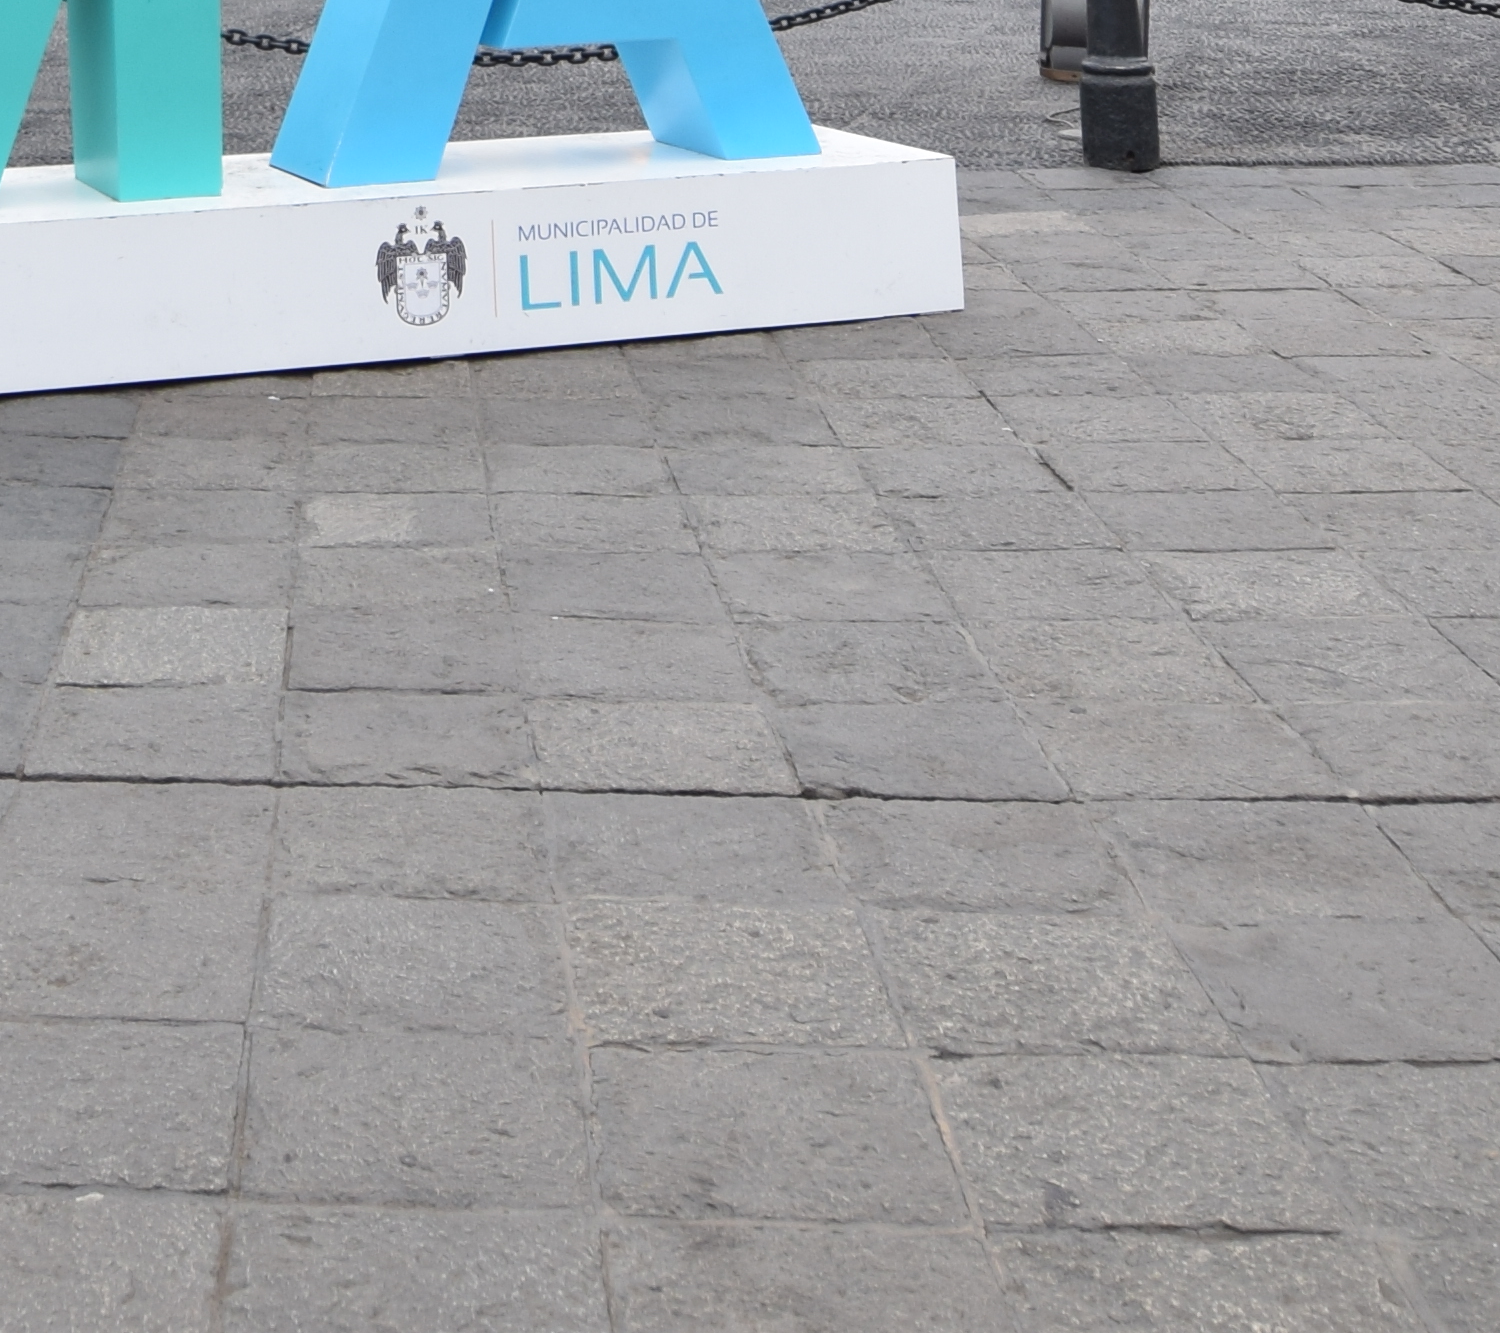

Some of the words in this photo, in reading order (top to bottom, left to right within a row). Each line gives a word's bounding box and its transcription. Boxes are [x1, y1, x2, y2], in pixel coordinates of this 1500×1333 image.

[518, 213, 687, 242] MUNICIPALIDAD
[692, 210, 719, 229] DE
[518, 240, 724, 311] LIMA
